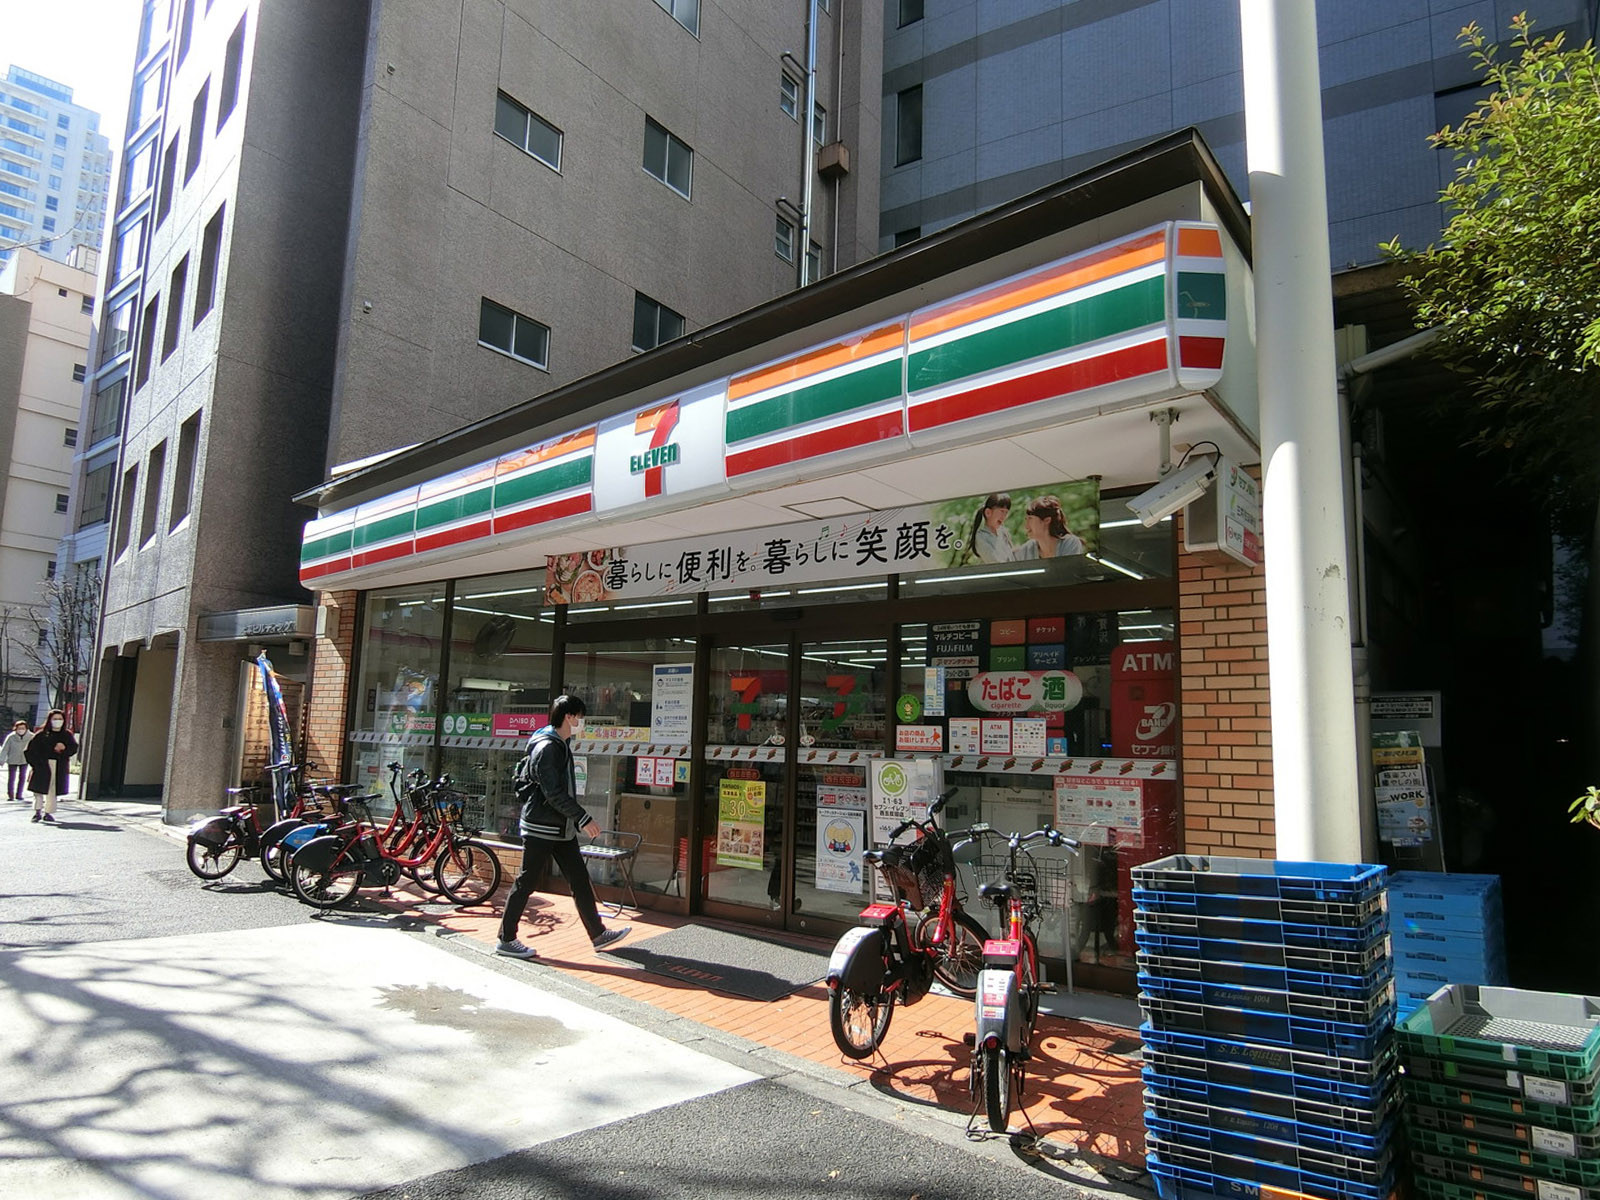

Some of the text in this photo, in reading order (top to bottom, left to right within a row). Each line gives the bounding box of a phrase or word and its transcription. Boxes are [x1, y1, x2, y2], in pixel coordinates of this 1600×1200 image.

[635, 399, 680, 497] 7
[1122, 653, 1173, 671] ATM
[982, 676, 1065, 701] たばこ 酒
[1141, 719, 1166, 727] BANK
[1390, 790, 1424, 802] WORK
[729, 800, 746, 817] 30
